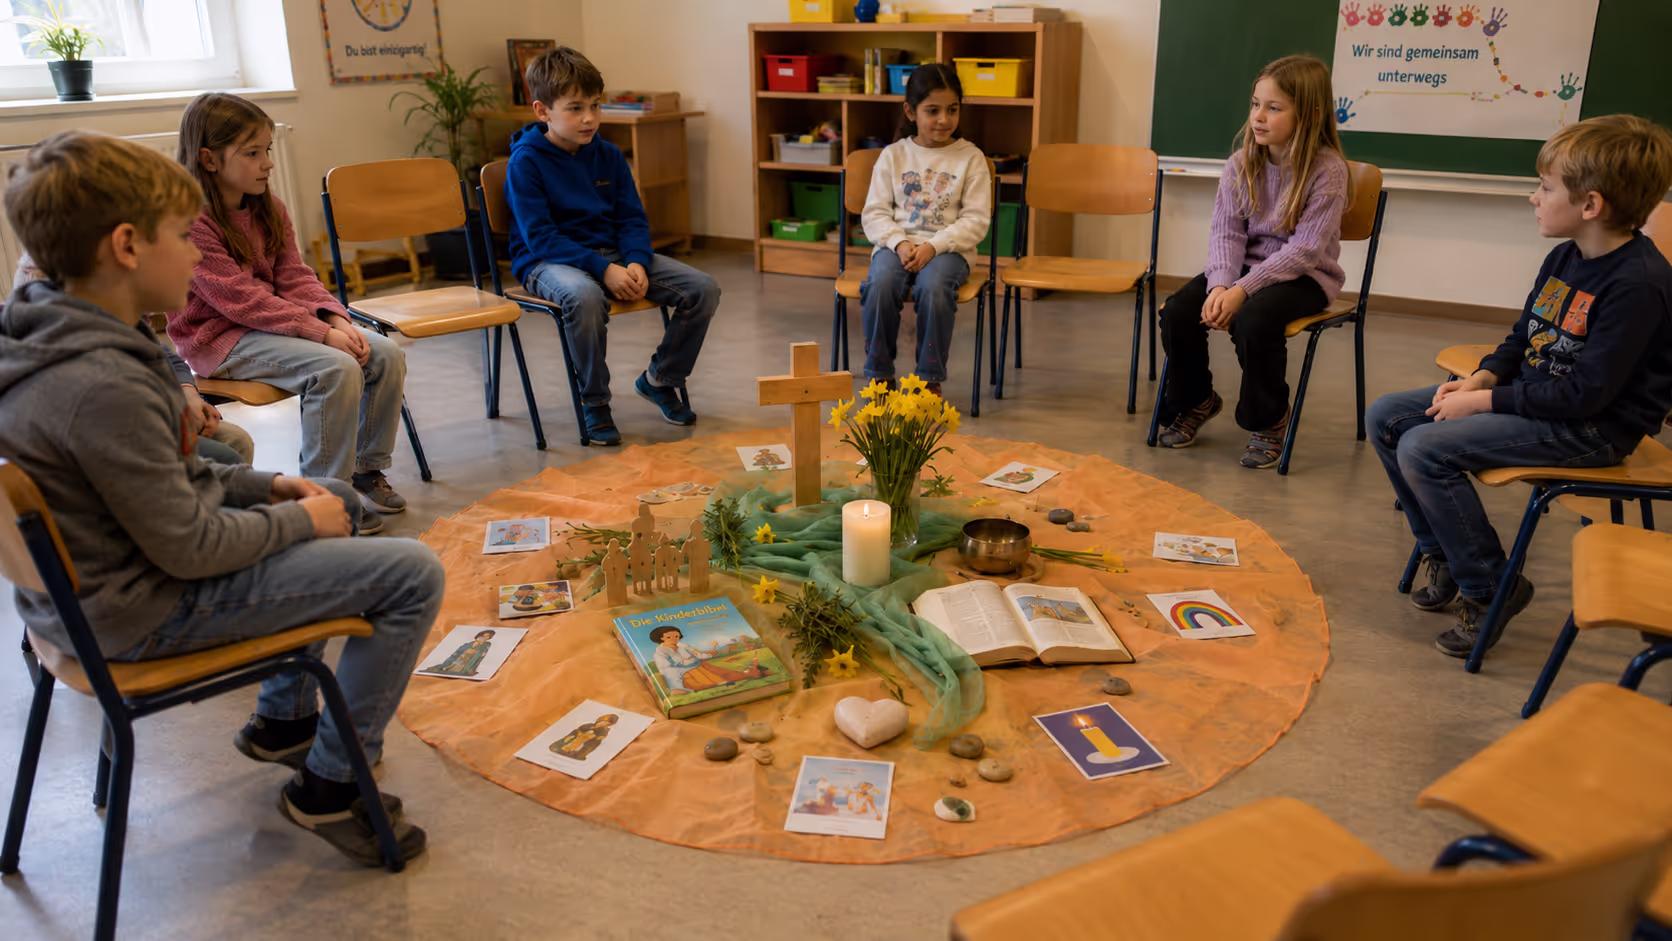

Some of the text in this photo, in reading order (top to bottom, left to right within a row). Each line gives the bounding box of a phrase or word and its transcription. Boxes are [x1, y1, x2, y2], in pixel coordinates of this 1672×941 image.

[345, 45, 358, 57] Du
[361, 44, 377, 57] bist
[1352, 44, 1479, 62] Wir sind gemeinsam
[1377, 70, 1447, 88] unterwegs
[629, 618, 653, 628] Die
